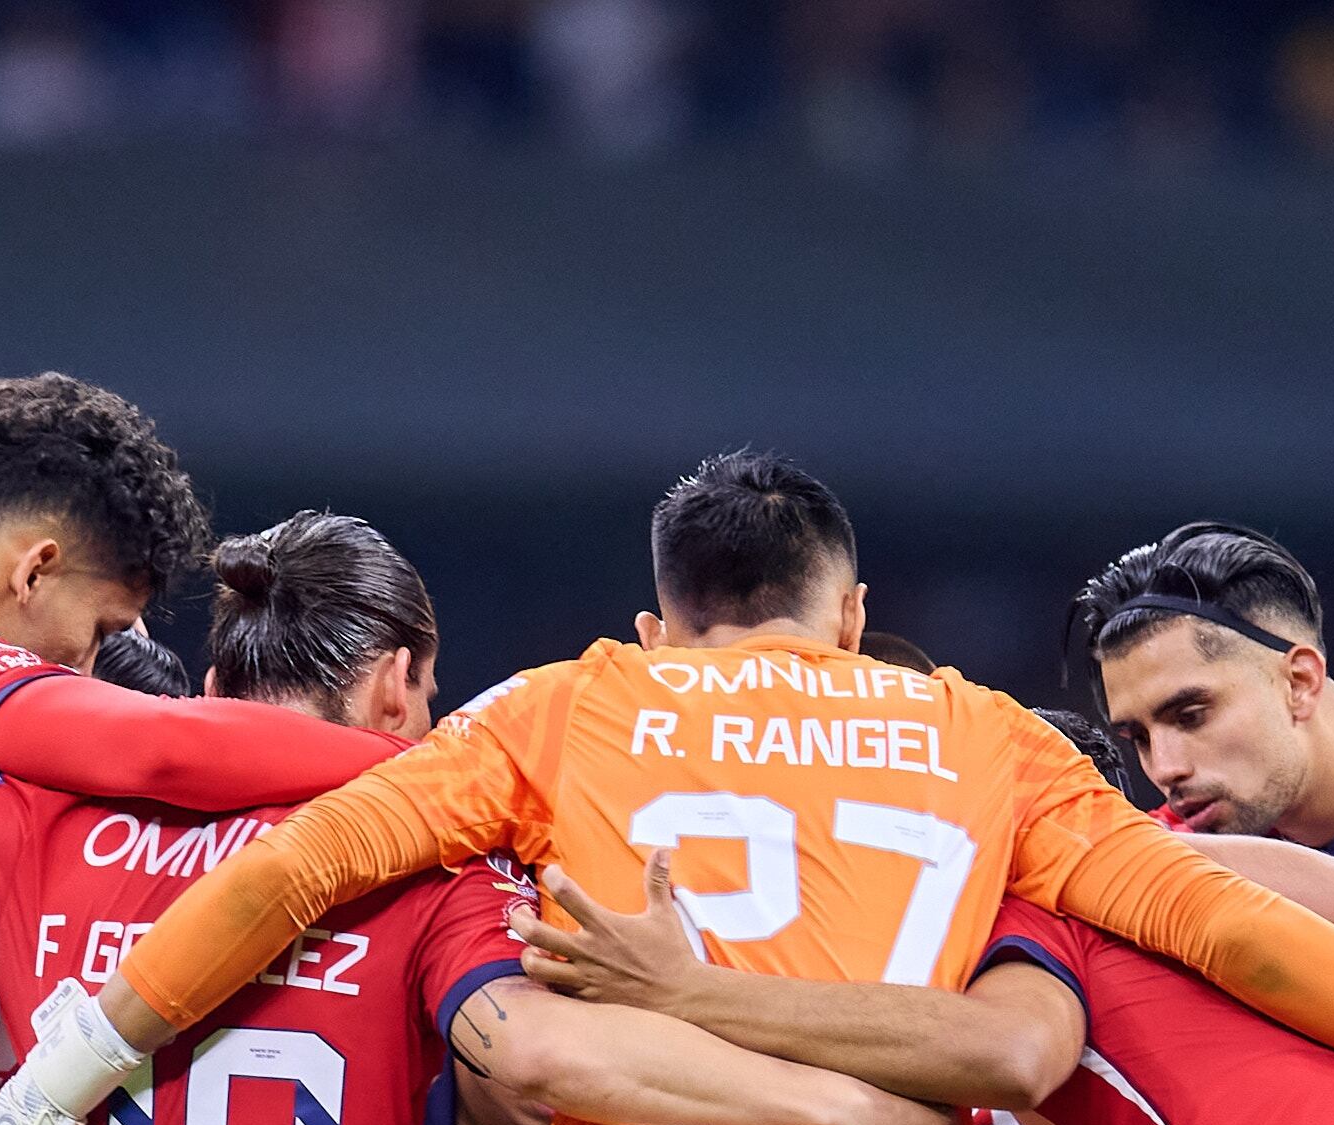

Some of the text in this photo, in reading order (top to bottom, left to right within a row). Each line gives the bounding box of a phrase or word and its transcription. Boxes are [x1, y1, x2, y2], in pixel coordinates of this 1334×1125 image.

[648, 655, 935, 702] OMNILIFE
[630, 709, 958, 782] R. RANGEL
[83, 813, 275, 878] OMNI
[629, 791, 979, 987] 27
